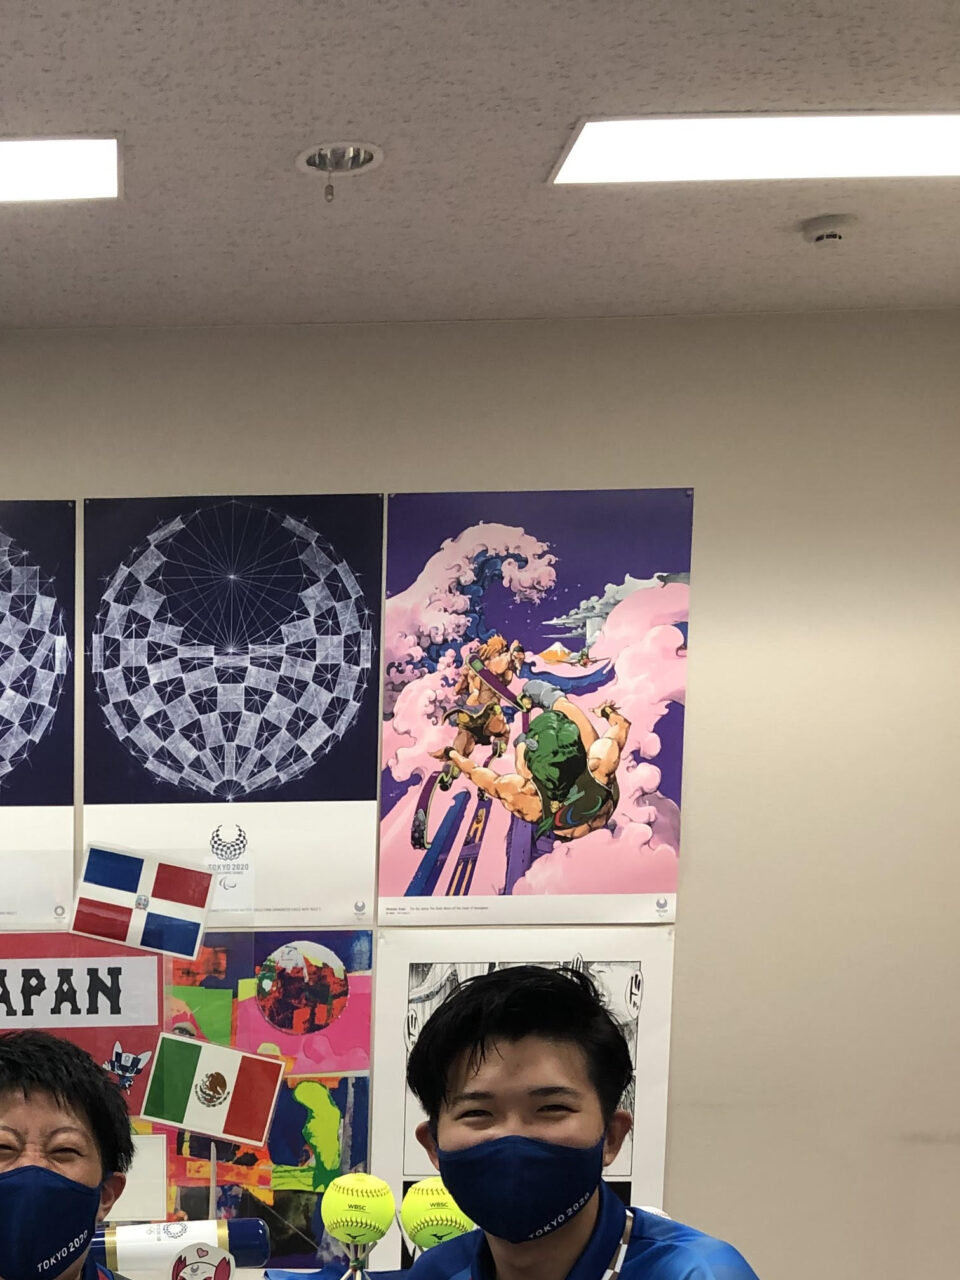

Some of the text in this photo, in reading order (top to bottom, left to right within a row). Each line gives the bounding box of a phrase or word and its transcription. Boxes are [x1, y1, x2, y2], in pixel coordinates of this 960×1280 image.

[231, 863, 249, 871] 2020
[347, 1203, 367, 1211] WBSC
[527, 1191, 590, 1239] TOKYO 2020
[37, 1229, 88, 1273] TOKYO 2020
